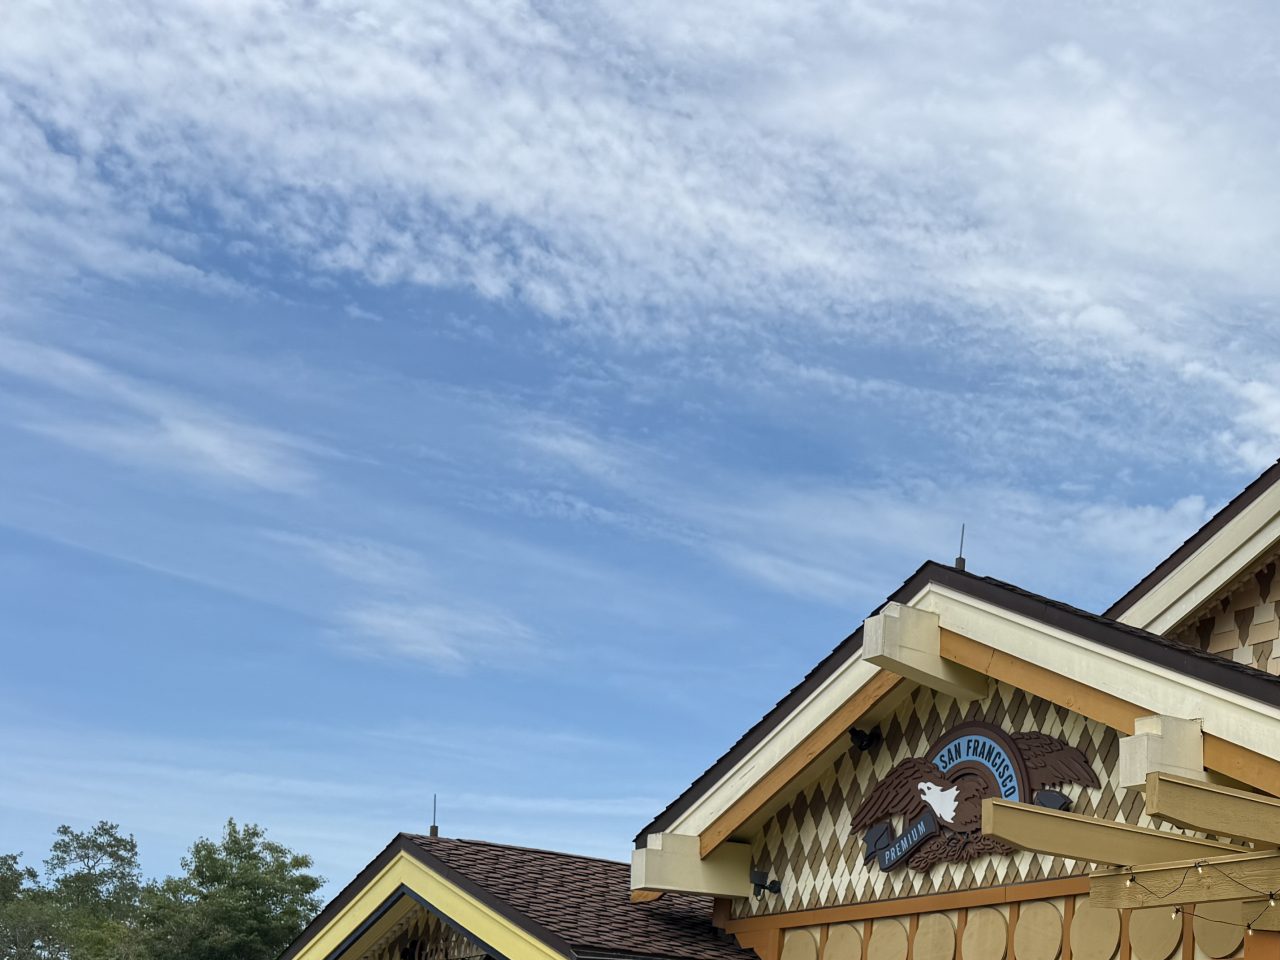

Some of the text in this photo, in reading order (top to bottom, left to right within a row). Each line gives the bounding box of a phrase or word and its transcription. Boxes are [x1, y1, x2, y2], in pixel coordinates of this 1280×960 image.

[939, 739, 1017, 798] SAN FRANCISCO
[884, 821, 926, 865] PREMIUM
